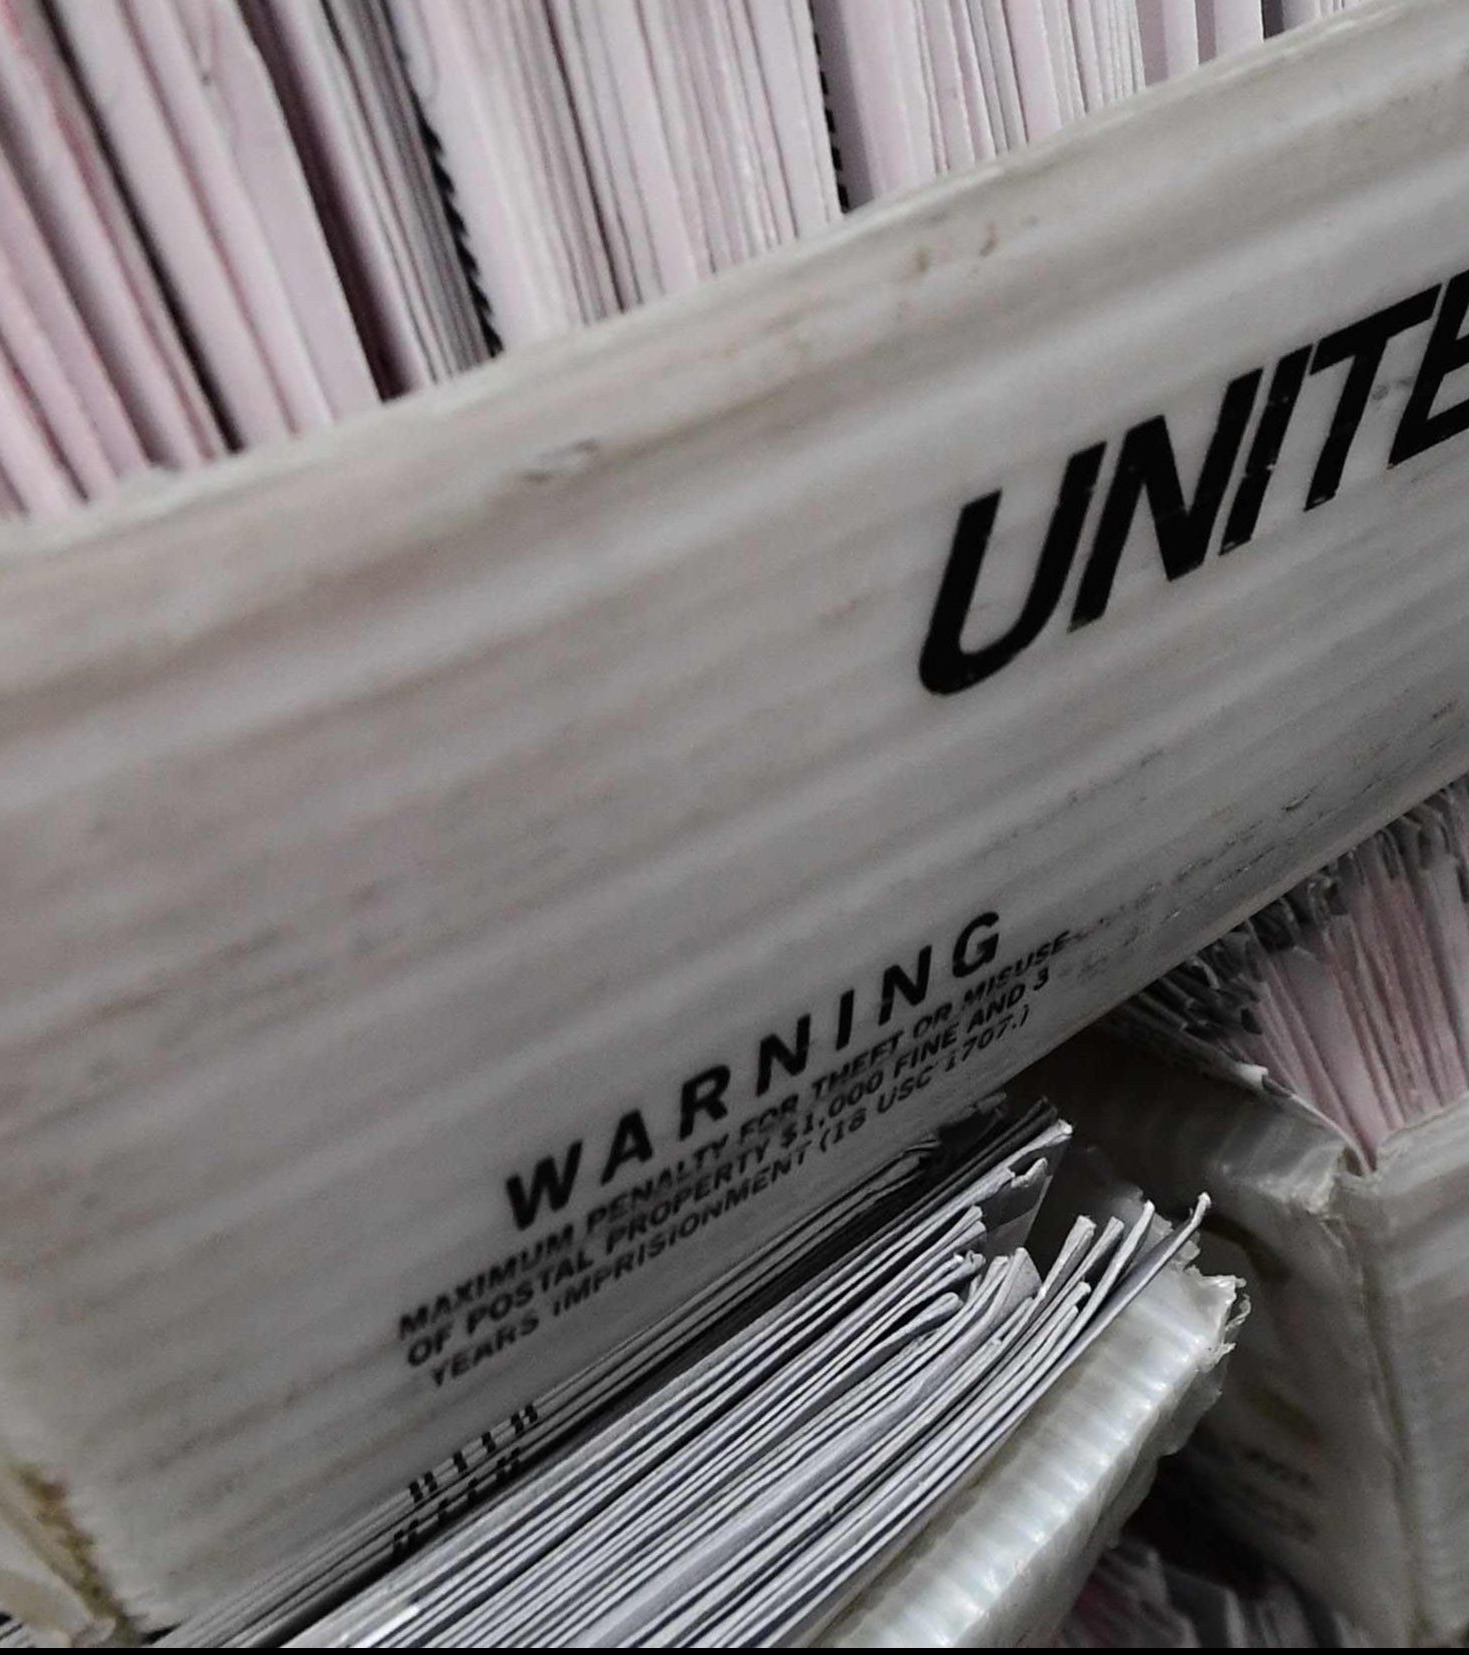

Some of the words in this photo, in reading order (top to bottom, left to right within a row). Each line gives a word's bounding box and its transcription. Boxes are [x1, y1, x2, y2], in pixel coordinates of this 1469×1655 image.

[397, 1223, 575, 1340] MAXIMUM
[586, 1133, 730, 1234] PENALTY
[739, 1093, 800, 1143] FOR
[811, 1029, 905, 1099] THEFT
[912, 1001, 953, 1040] OR
[963, 930, 1071, 1006] MISUSE
[406, 1320, 455, 1367] OF
[466, 1249, 595, 1336] POSTAL
[605, 1137, 771, 1255] PROPERTY
[780, 1071, 884, 1150] $1,000
[893, 1022, 959, 1080] FINE
[967, 982, 1026, 1033] AND
[1032, 965, 1051, 992] 3
[430, 1310, 540, 1388] YEARS
[819, 1107, 868, 1154] (18
[877, 1064, 933, 1115] USC
[505, 911, 1000, 1232] WARNING
